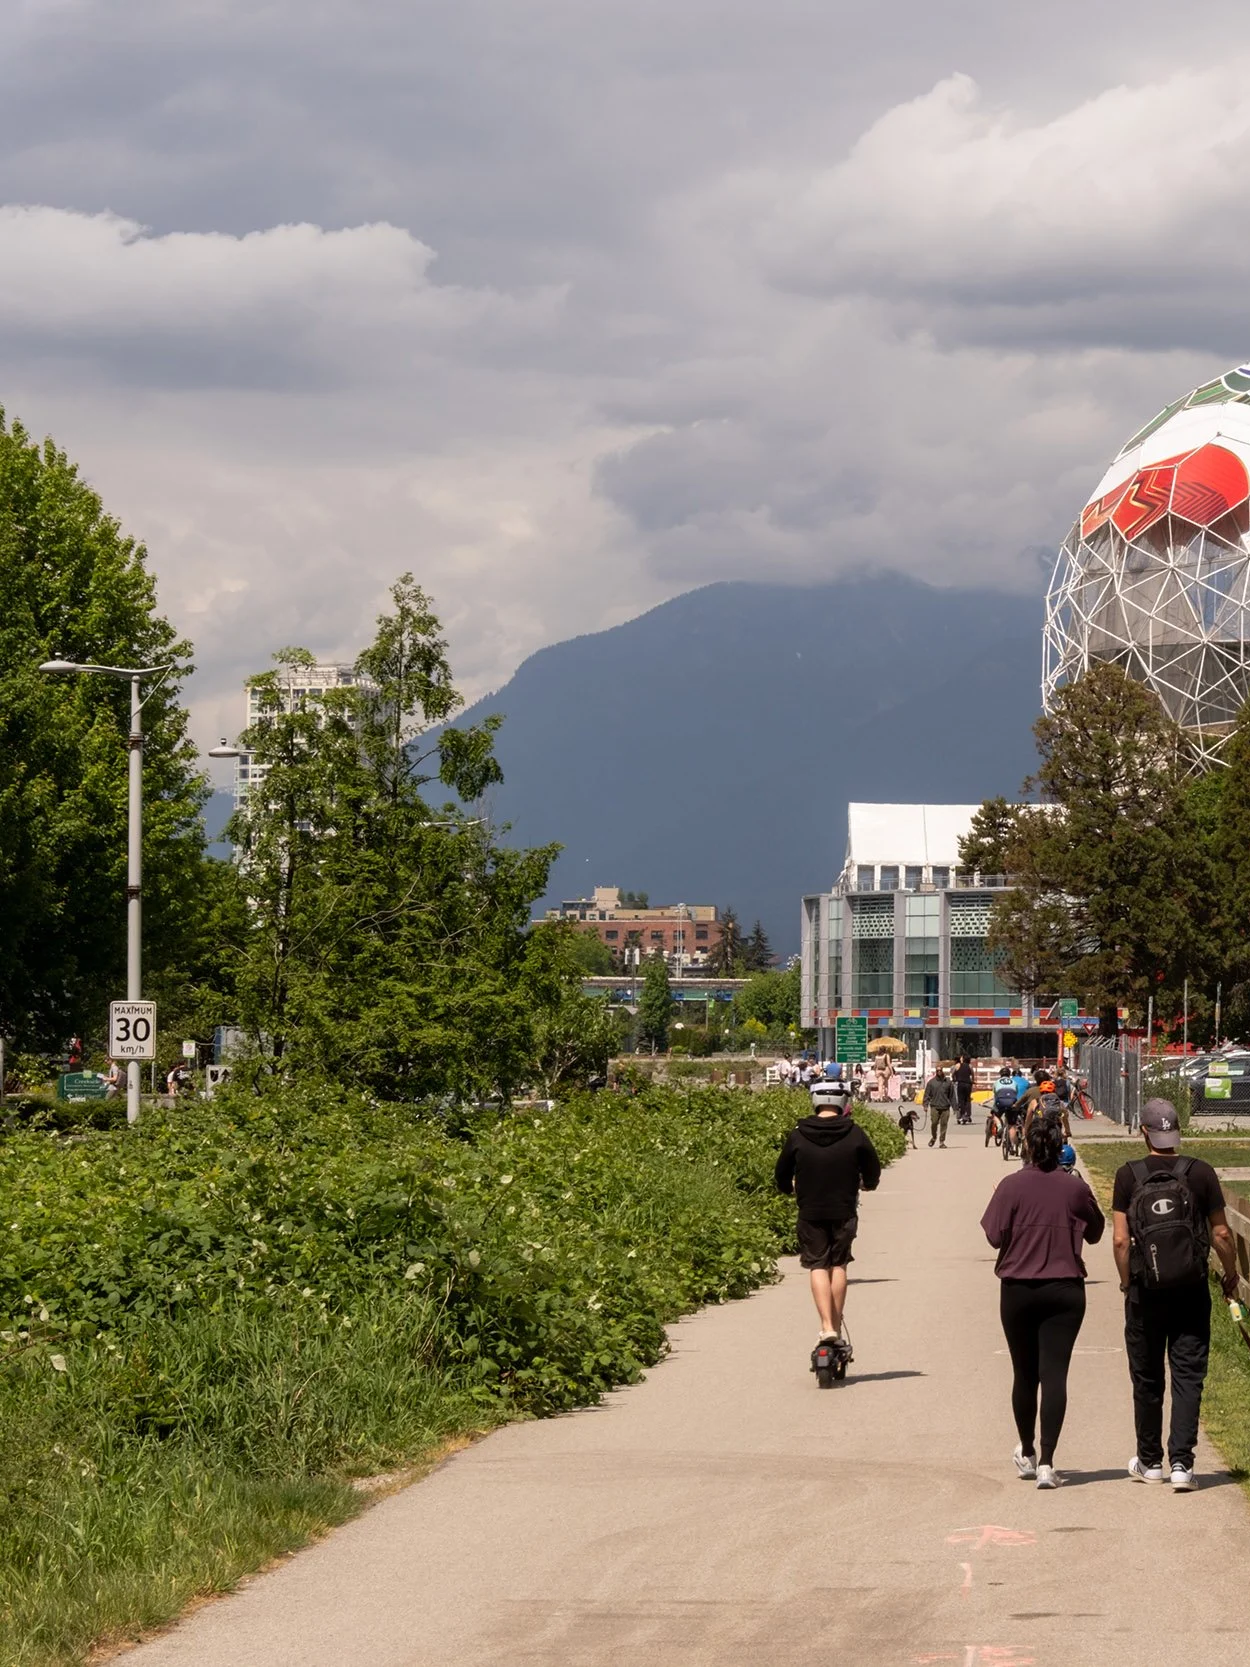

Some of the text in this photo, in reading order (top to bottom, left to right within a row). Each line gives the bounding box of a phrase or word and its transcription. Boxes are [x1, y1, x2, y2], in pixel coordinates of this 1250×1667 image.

[114, 1006, 152, 1014] MAXIMUM
[115, 1017, 150, 1042] 30
[120, 1045, 145, 1054] km/h
[1161, 1117, 1171, 1131] LA
